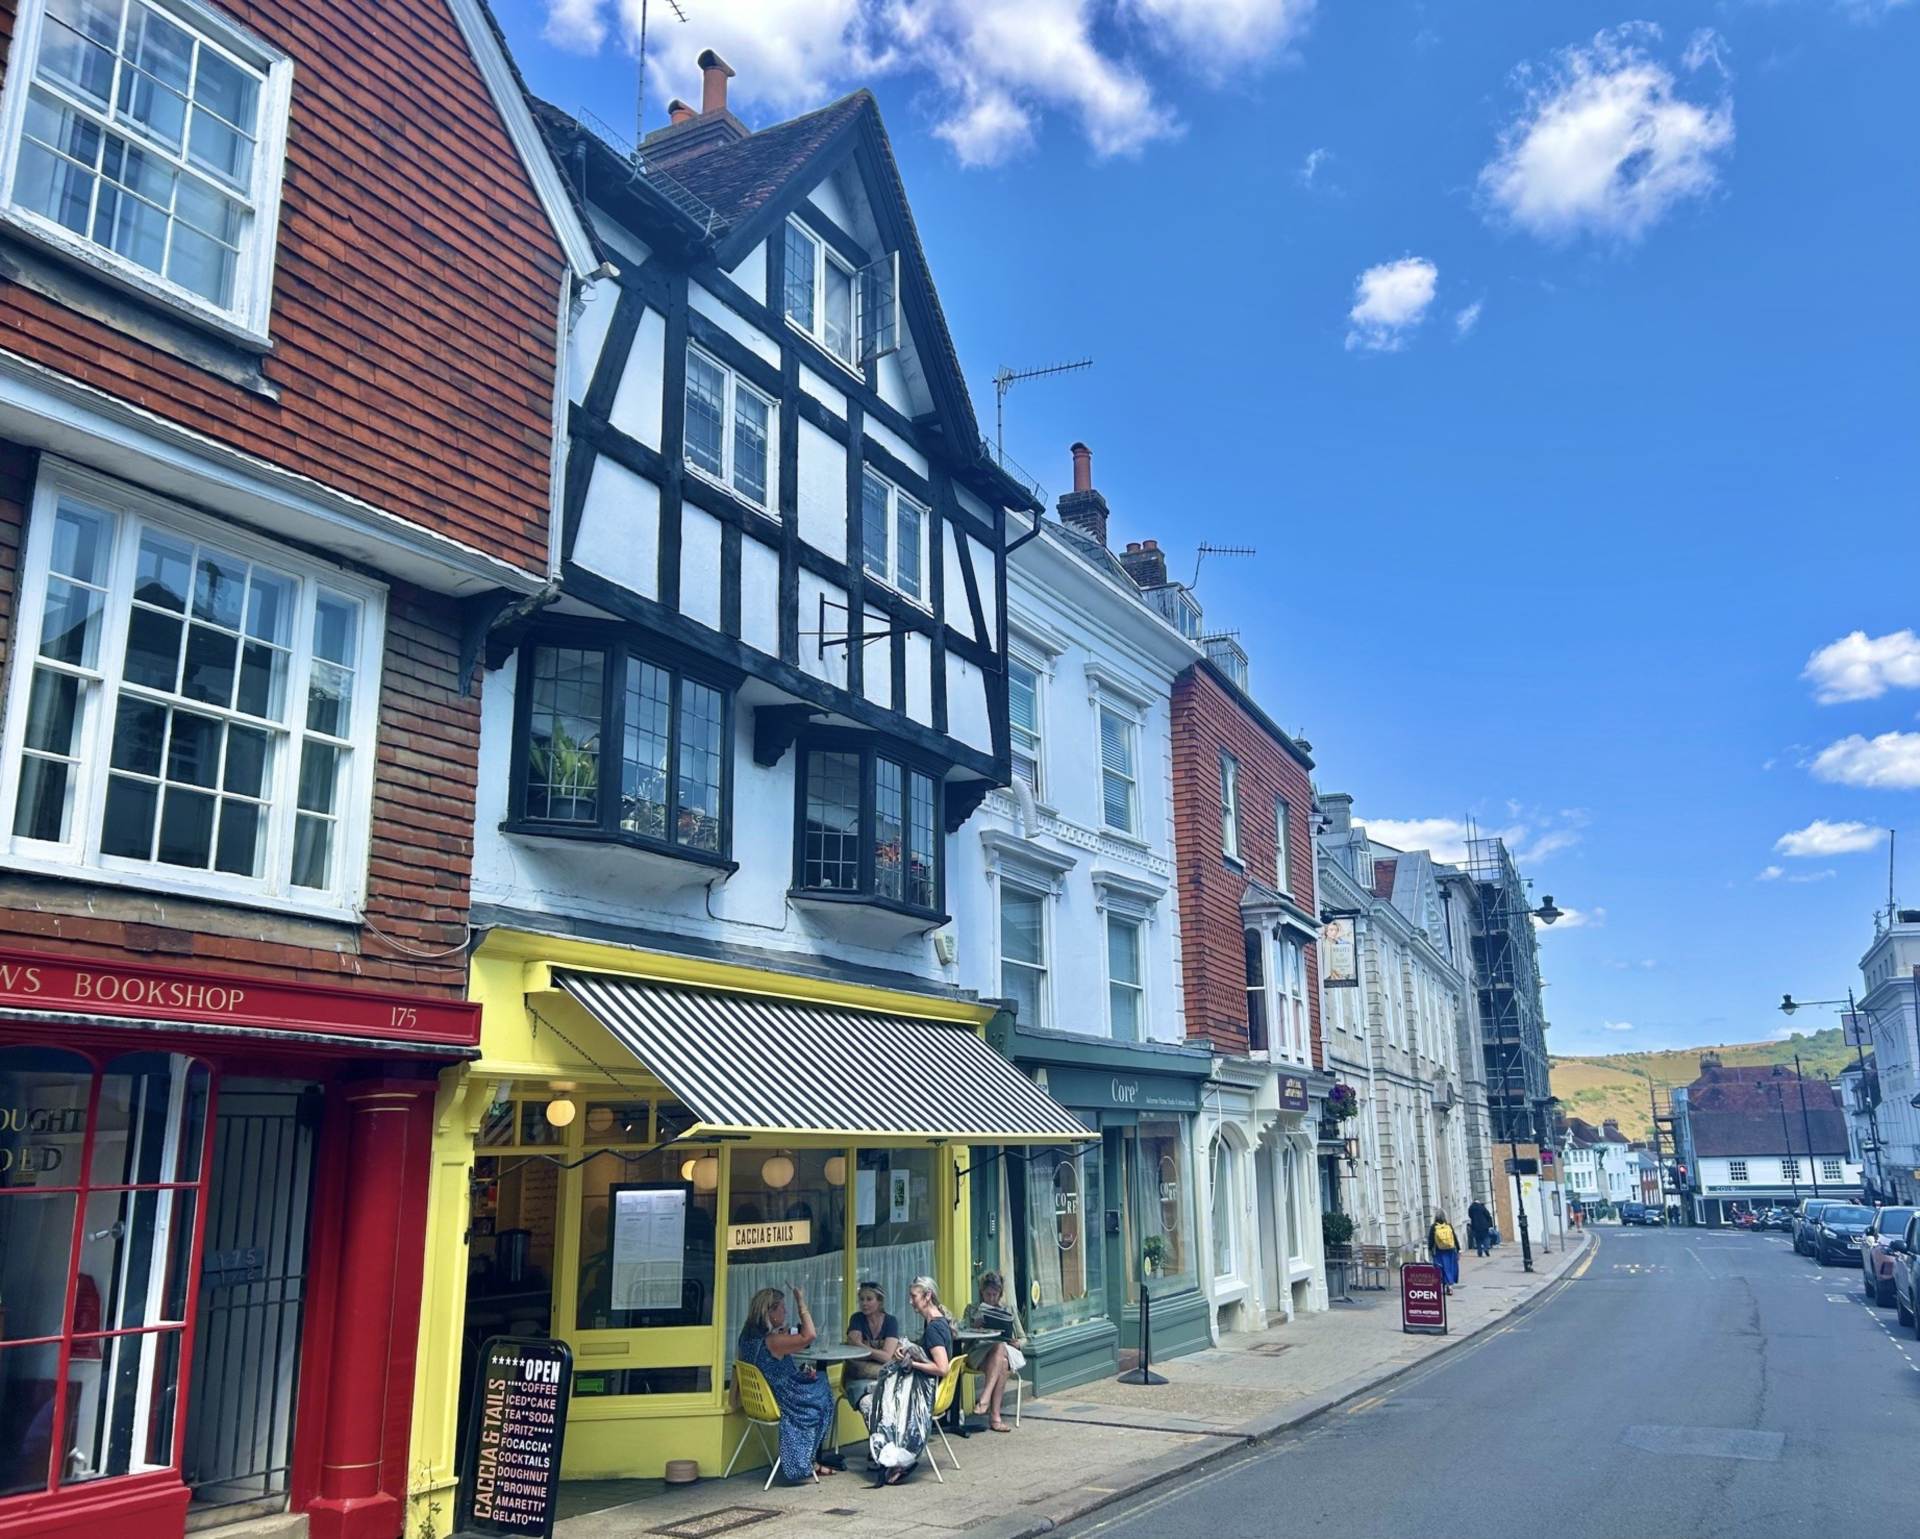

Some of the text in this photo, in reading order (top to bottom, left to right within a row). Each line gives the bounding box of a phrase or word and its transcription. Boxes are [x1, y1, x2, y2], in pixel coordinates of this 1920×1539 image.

[73, 972, 244, 1012] BOOKSHOP
[391, 1006, 417, 1029] 175
[735, 1227, 766, 1246] CACCIA
[772, 1225, 794, 1242] TAILS
[1408, 1290, 1438, 1300] OPEN
[484, 1378, 506, 1427] TAILS
[498, 1451, 551, 1468] COCKTAILS
[473, 1447, 499, 1519] CACCIA
[497, 1466, 549, 1483] DOUGHNUT
